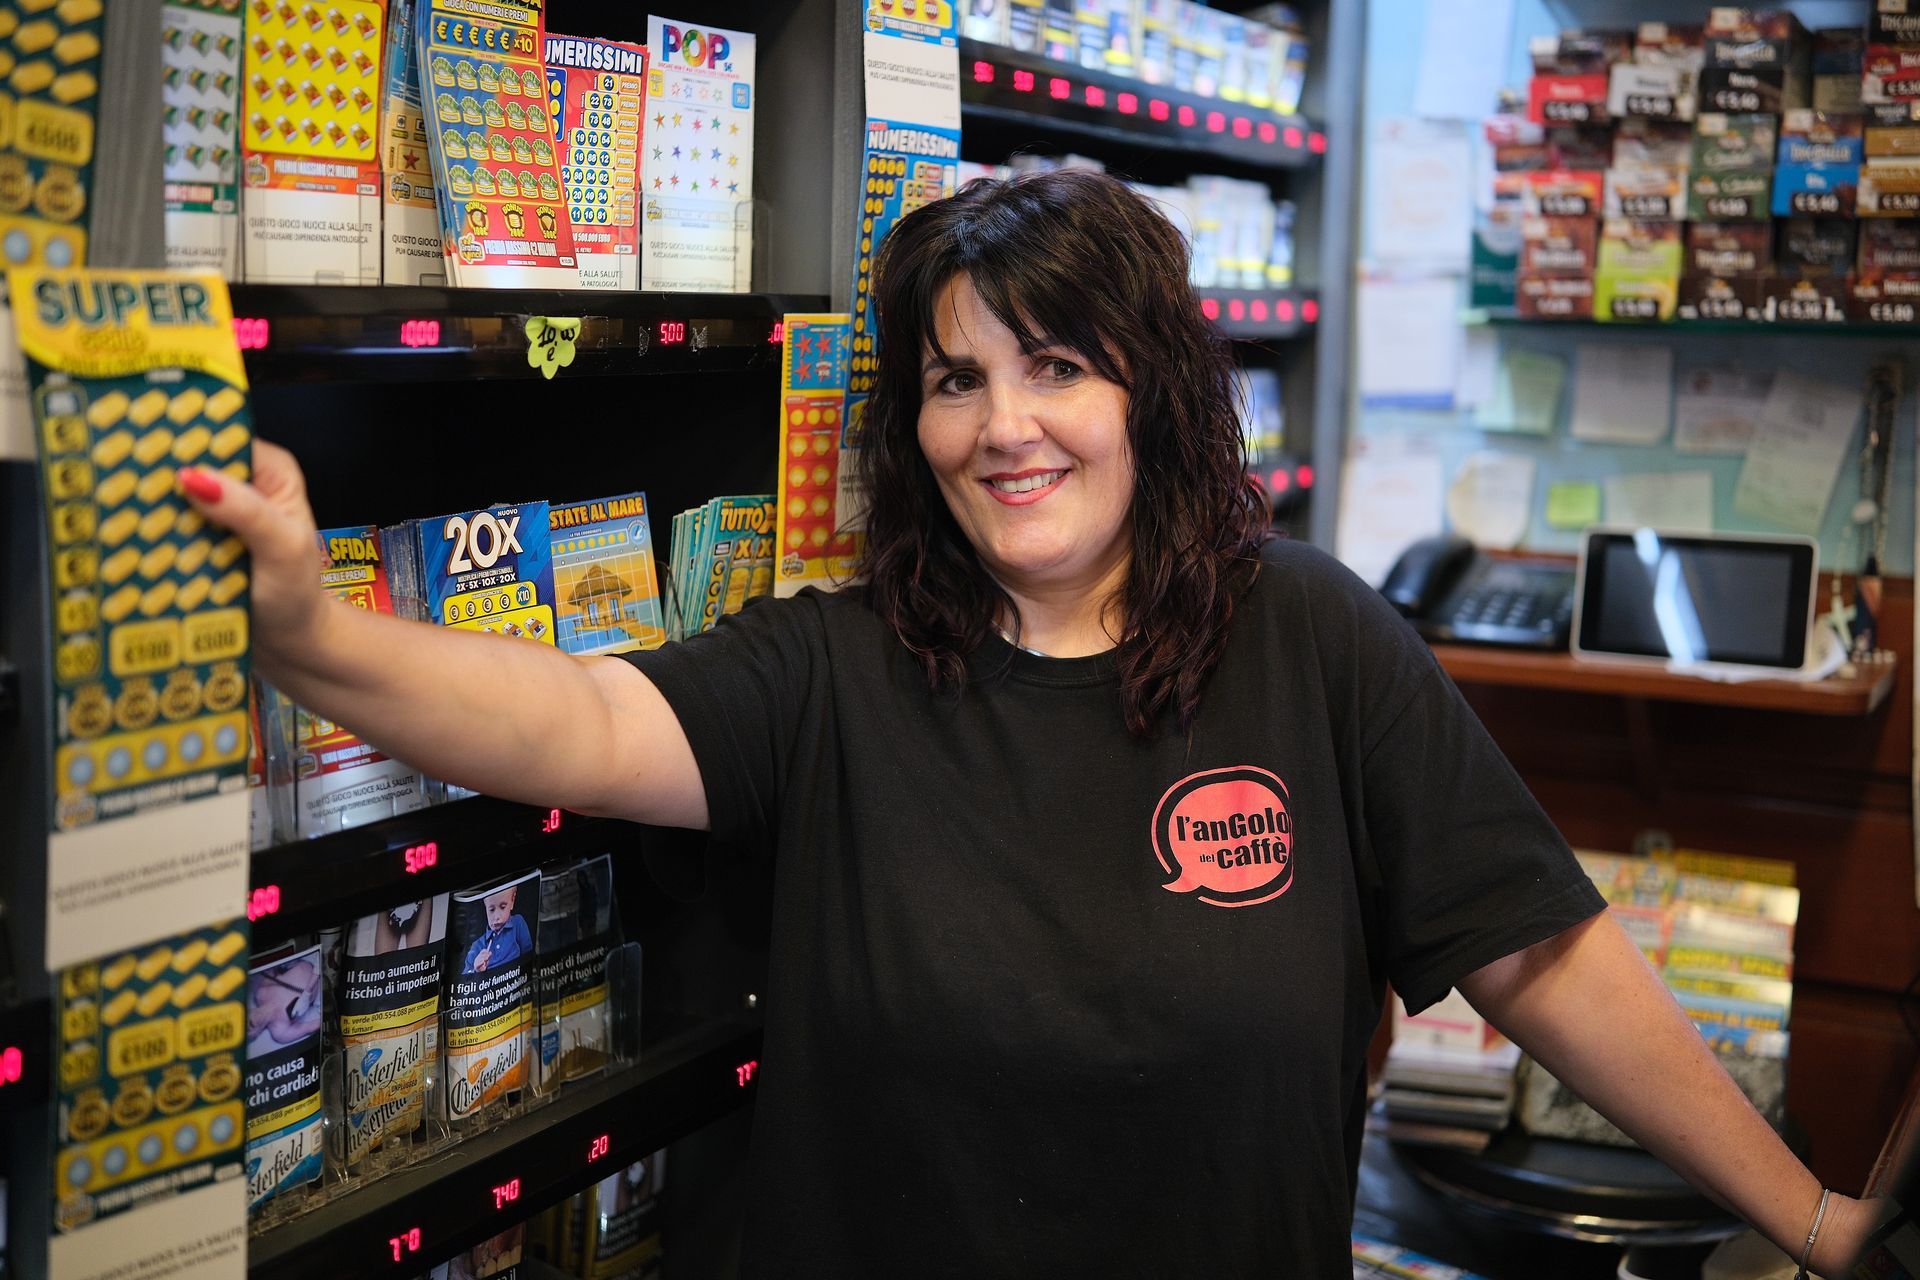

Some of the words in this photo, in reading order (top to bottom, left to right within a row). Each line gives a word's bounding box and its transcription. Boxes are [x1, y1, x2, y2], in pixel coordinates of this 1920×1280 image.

[509, 8, 529, 22] PREMI
[545, 39, 643, 74] UMERISSIMI
[662, 24, 730, 70] POP
[604, 78, 614, 86] 21
[867, 128, 959, 158] NUMERISSIMI
[571, 211, 581, 219] 11
[35, 278, 218, 327] SUPER
[497, 508, 518, 517] NUOVO
[549, 505, 590, 531] STATE
[589, 503, 608, 523] AL
[607, 495, 645, 520] MARE
[329, 537, 380, 561] SFIDA
[443, 511, 524, 576] 20X
[320, 571, 341, 584] UMERI
[517, 589, 530, 602] X10
[375, 782, 392, 792] ALLA
[391, 775, 415, 788] SALUTE
[1176, 807, 1289, 842] l'anGolo
[1199, 854, 1215, 863] del
[1216, 836, 1288, 870] caffè
[346, 970, 355, 983] Il
[358, 970, 386, 983] fumo
[387, 958, 430, 977] aumenta
[430, 954, 437, 968] il
[565, 954, 574, 969] di
[345, 985, 383, 1000] rischio
[384, 981, 395, 995] di
[450, 983, 455, 994] I
[457, 982, 477, 996] figli
[478, 978, 492, 991] dei
[491, 965, 521, 987] fumatori
[449, 996, 481, 1007] hanno
[482, 989, 495, 1005] più
[450, 1010, 460, 1021] di
[462, 1001, 504, 1019] cominciare
[503, 997, 509, 1006] a
[266, 1056, 305, 1081] causa
[450, 1036, 518, 1116] Chesterfield
[249, 1131, 303, 1198] sterfield
